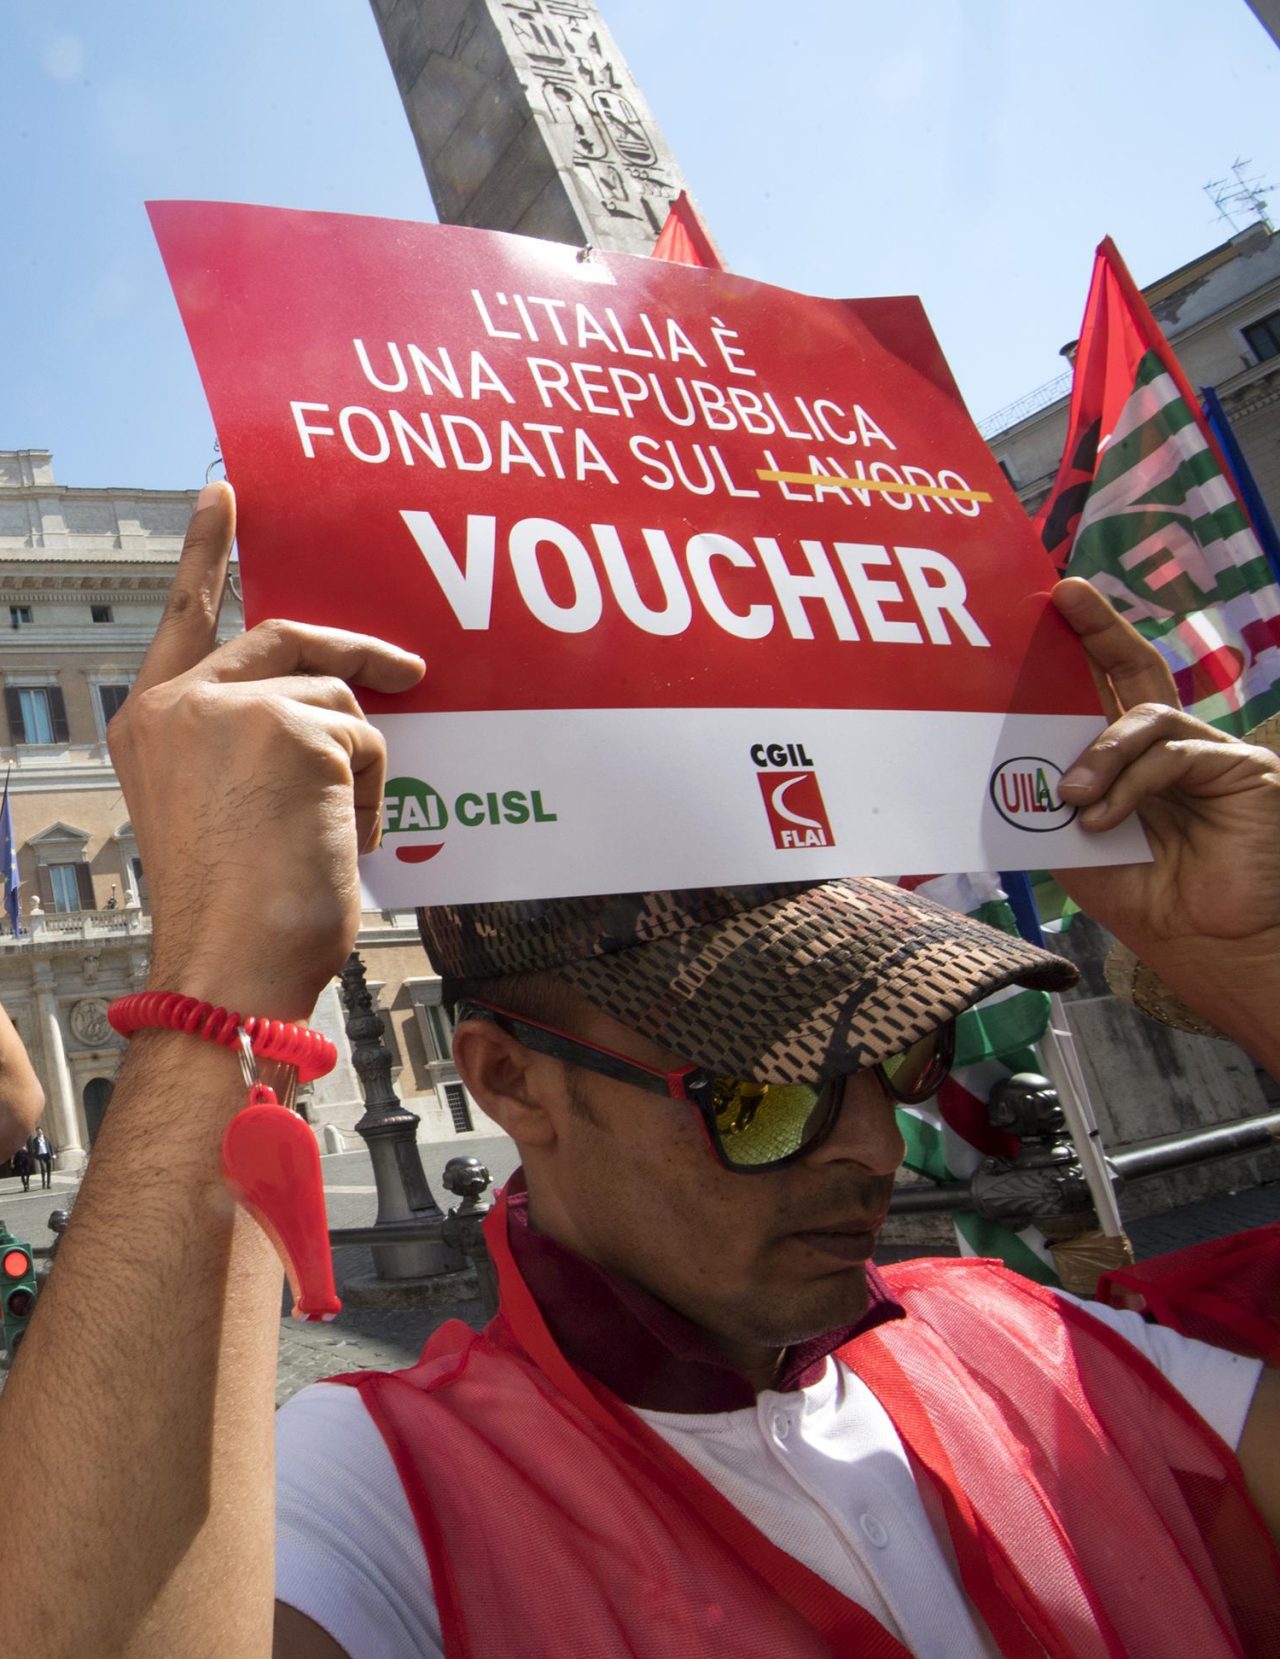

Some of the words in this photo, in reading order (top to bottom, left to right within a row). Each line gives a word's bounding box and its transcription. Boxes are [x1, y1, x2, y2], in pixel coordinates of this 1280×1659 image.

[471, 287, 708, 368] L'ITALIA
[708, 316, 758, 377] È
[351, 337, 507, 405] UNA
[521, 353, 898, 451] REPUBBLICA
[289, 400, 620, 485] FONDATA
[627, 434, 762, 498] SUL
[762, 449, 982, 518] LAVORO
[398, 509, 992, 648] VOUCHER
[749, 743, 815, 768] CGIL
[382, 793, 442, 830] FAI
[454, 790, 558, 827] CISL
[780, 828, 828, 848] FLAI
